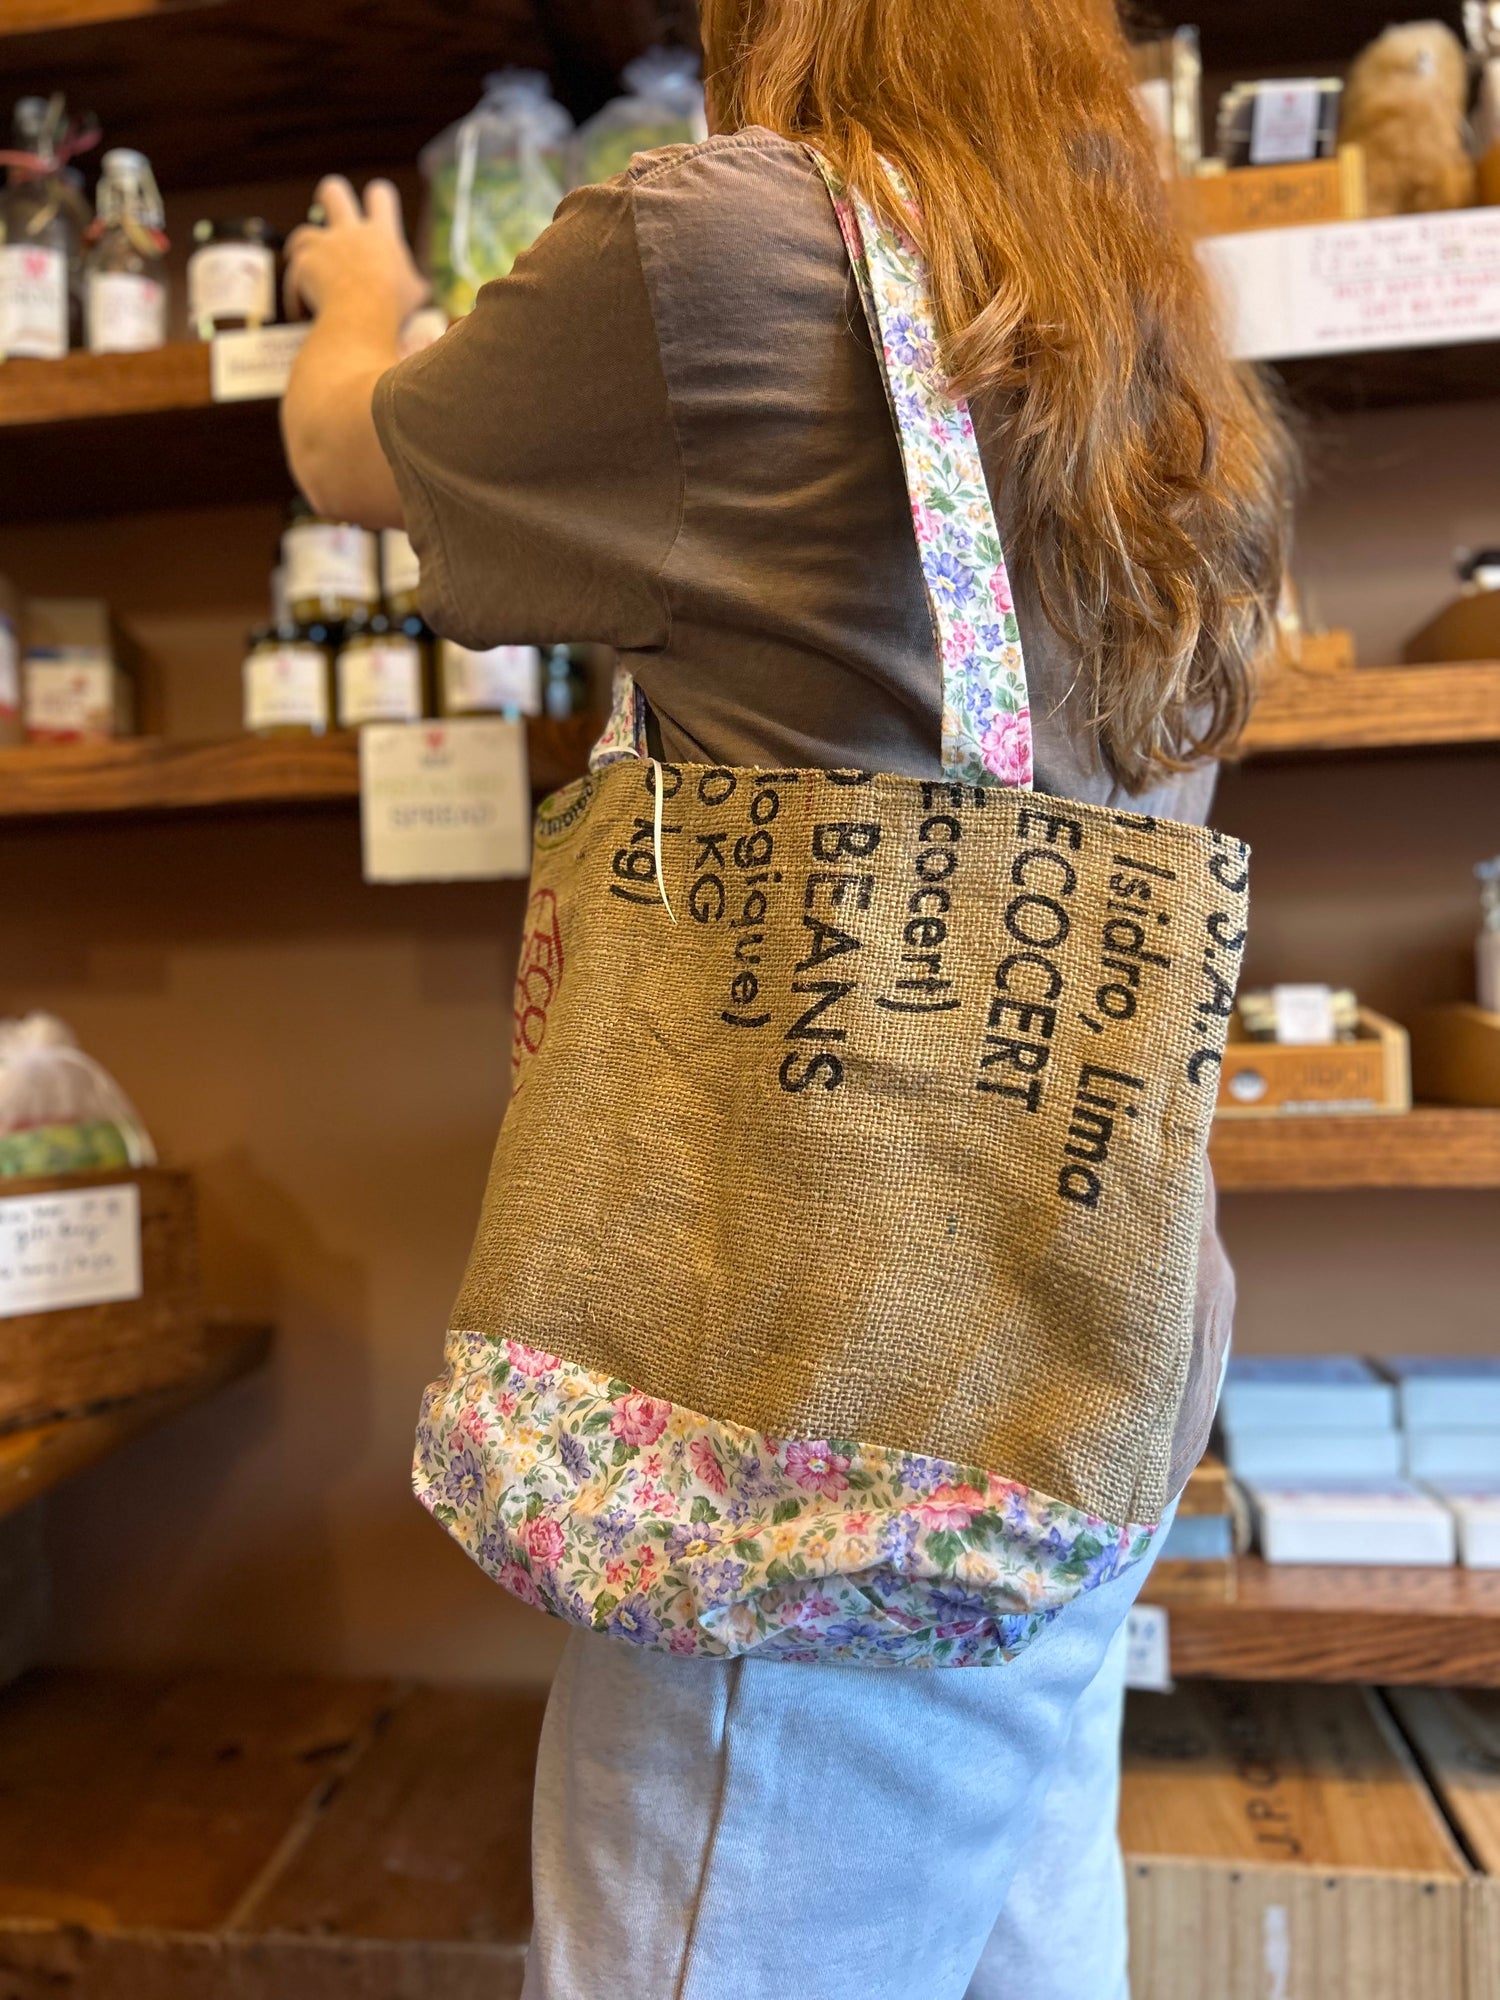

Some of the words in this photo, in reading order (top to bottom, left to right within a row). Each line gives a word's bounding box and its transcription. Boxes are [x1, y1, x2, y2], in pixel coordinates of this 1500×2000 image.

[609, 817, 683, 904] kg)
[688, 833, 729, 923] KG
[521, 929, 554, 1054] ECO
[778, 822, 882, 1093] BEANS
[976, 809, 1082, 1114] ECOCERT
[1078, 854, 1176, 1033] Isidro,
[1056, 1063, 1144, 1209] Lima
